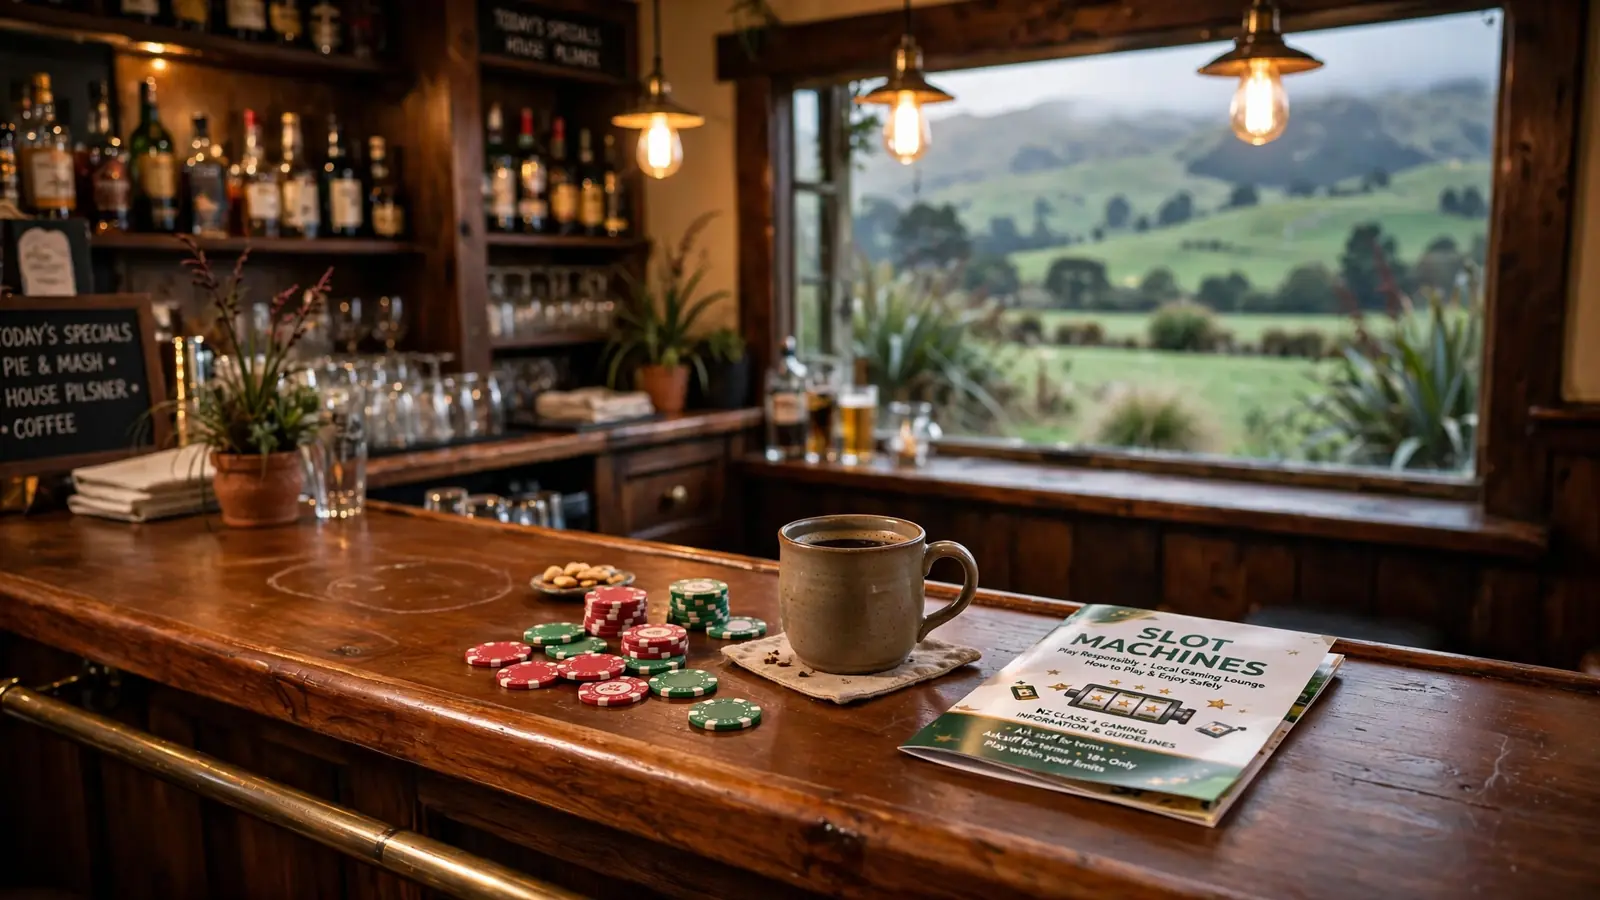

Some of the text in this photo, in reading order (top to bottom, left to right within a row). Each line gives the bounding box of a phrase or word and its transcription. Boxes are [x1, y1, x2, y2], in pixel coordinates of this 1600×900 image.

[0, 321, 133, 347] ODAY'S SPECIALS
[2, 352, 104, 377] PIE & MASH
[4, 378, 129, 408] HOUSE PILSNER
[13, 412, 77, 439] COFFEE
[1137, 627, 1234, 652] SLOT
[1057, 647, 1266, 689] Play Responsibly Local Gaming Lounge
[1070, 633, 1268, 677] MACHINES
[1084, 660, 1109, 669] How
[1123, 666, 1145, 676] Play
[1158, 672, 1188, 684] Enjoy
[1189, 678, 1223, 690] Safely
[1053, 711, 1089, 723] CLASS
[1100, 721, 1148, 735] GAMING
[1104, 730, 1177, 749] GUIDELINES
[983, 739, 1105, 773] Play within your limits
[1108, 758, 1138, 771] Only
